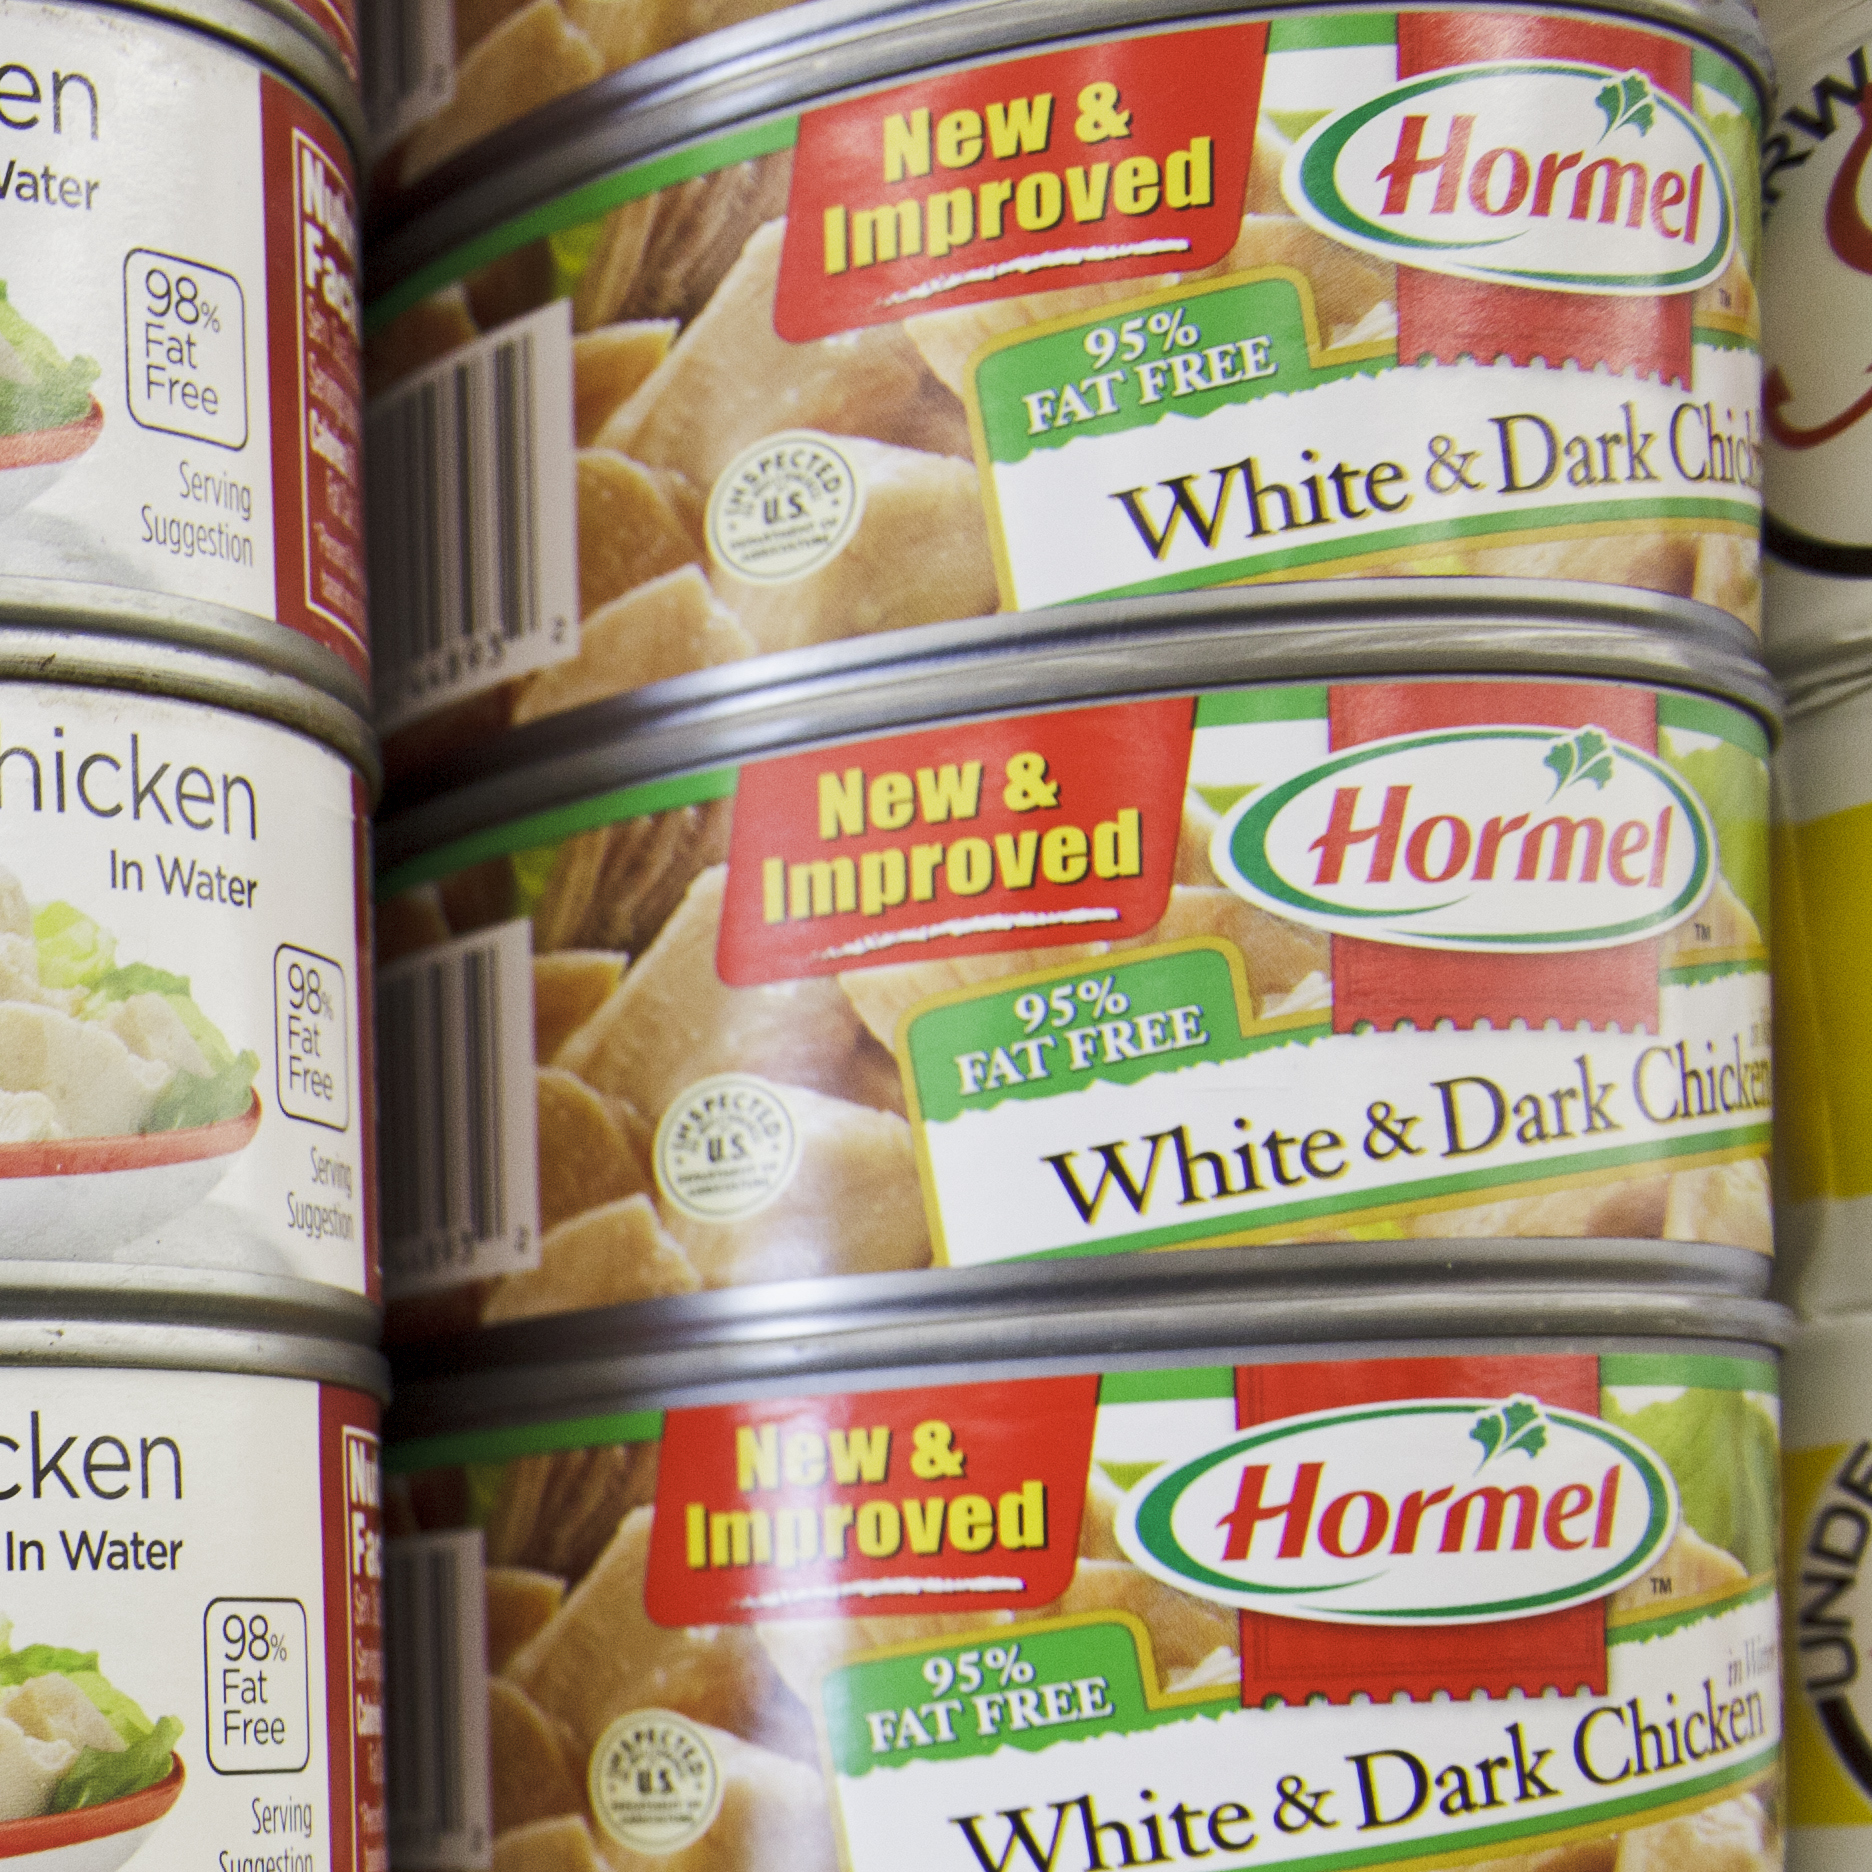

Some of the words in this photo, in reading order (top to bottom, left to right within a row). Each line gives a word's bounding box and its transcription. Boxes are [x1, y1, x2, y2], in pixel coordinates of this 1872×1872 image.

[883, 86, 1055, 184] New
[1073, 80, 1132, 140] &
[820, 136, 1215, 279] Improved
[1377, 116, 1704, 246] Hormel
[1309, 784, 1674, 889] Hormel
[735, 1420, 890, 1490] New
[909, 1418, 964, 1481] &
[684, 1479, 1047, 1572] Improved
[1218, 1459, 1621, 1561] Hormel
[5, 1530, 44, 1571] In
[57, 1528, 183, 1572] Water
[220, 1615, 287, 1663] 98%
[921, 1645, 1035, 1690] 95%
[222, 1670, 269, 1705] Fat
[867, 1696, 969, 1751] FAT
[974, 1675, 1111, 1727] FREE
[222, 1711, 286, 1745] Free
[1273, 1775, 1340, 1832] &
[1344, 1734, 1556, 1832] Dark
[1572, 1681, 1766, 1786] Chicken
[250, 1797, 313, 1843] Serving
